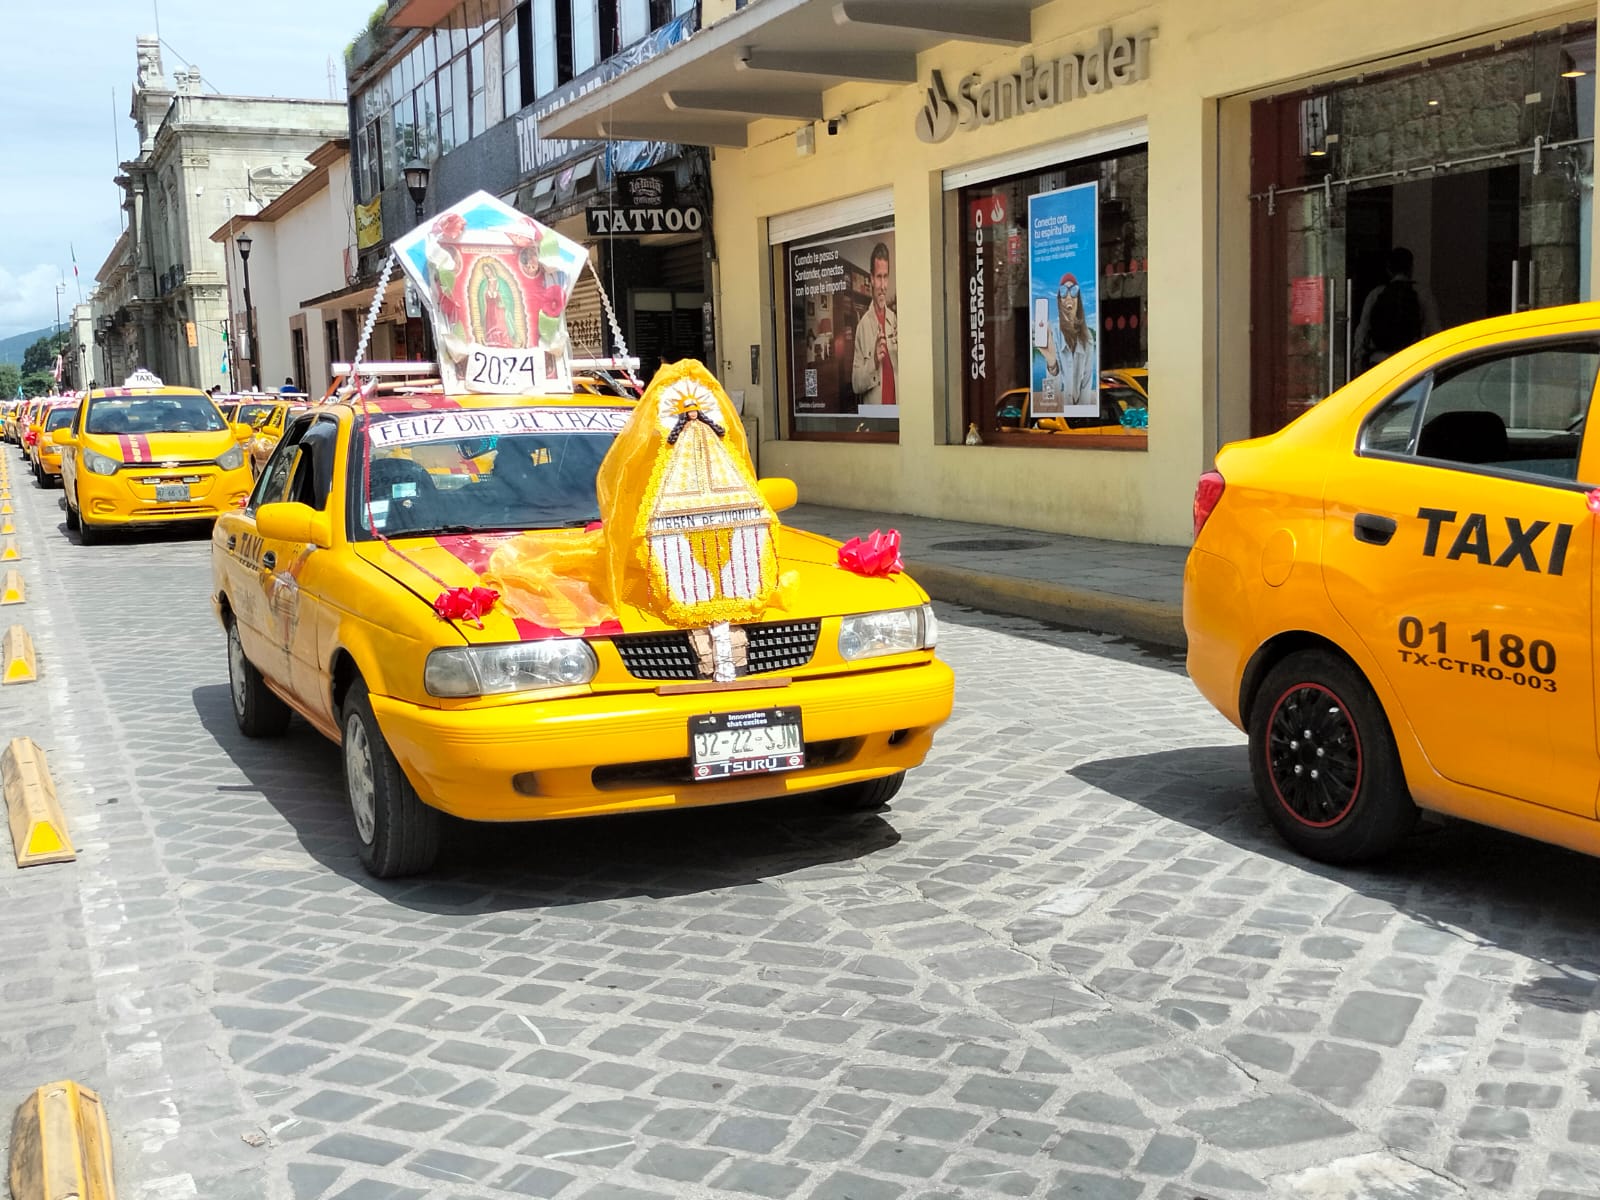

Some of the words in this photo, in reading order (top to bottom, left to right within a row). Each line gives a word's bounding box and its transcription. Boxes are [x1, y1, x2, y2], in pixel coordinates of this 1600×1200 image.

[957, 27, 1159, 132] Santander
[592, 208, 702, 232] TATTOO
[1034, 216, 1057, 228] Conecta
[1057, 215, 1067, 224] con
[1062, 223, 1076, 234] libre
[794, 253, 813, 266] Cuando
[813, 252, 819, 263] te
[821, 264, 844, 277] conectas
[795, 287, 805, 297] con
[804, 284, 810, 296] lo
[810, 285, 819, 297] que
[819, 282, 825, 293] te
[825, 280, 846, 295] importa
[970, 276, 979, 380] CAJERO
[135, 374, 153, 382] TAXI
[473, 351, 536, 386] 2024
[380, 418, 445, 441] FELIZ
[455, 413, 494, 432] DIA
[702, 515, 715, 526] DE
[240, 532, 265, 563] TAXI
[1417, 507, 1574, 576] TAXI
[1398, 616, 1447, 654] 01
[1471, 629, 1557, 675] 180
[1398, 650, 1558, 693] TX-CTRO-003
[726, 719, 742, 728] that
[743, 719, 768, 728] excites
[728, 712, 766, 721] Innovation
[696, 723, 799, 757] 32-22-SJN
[719, 757, 777, 773] TSURU
